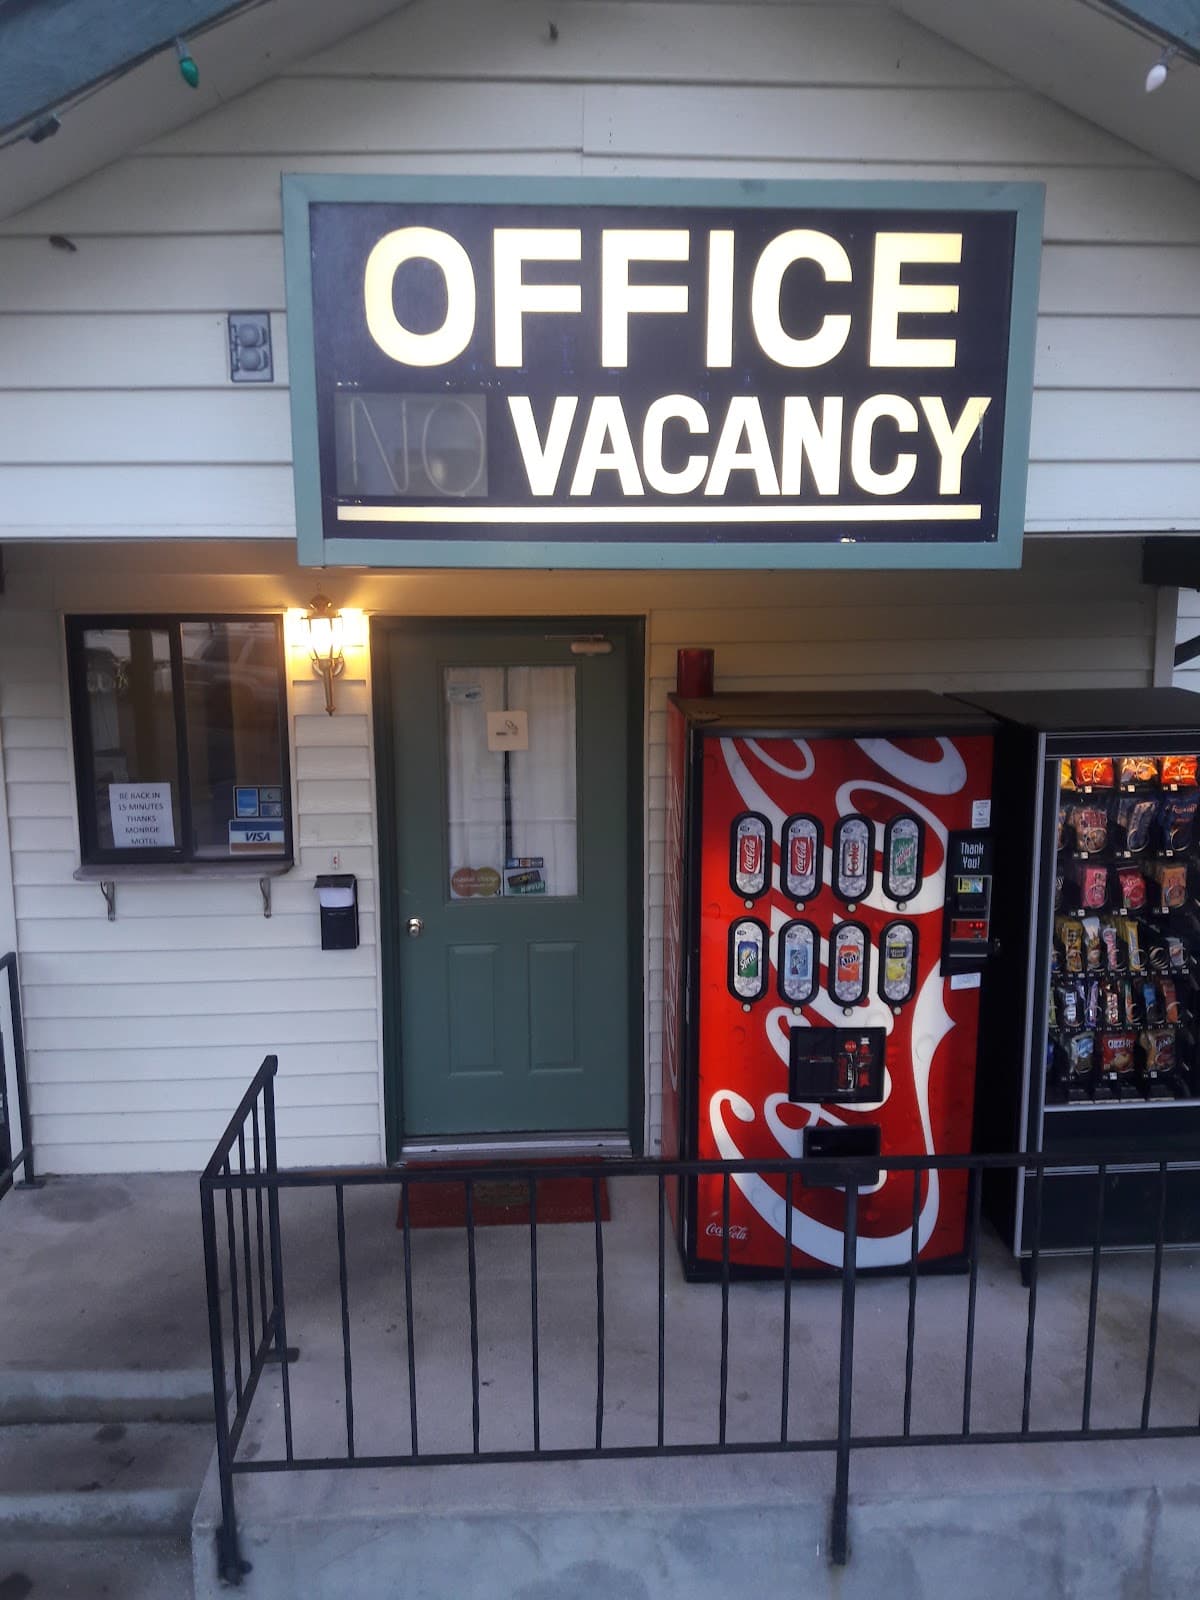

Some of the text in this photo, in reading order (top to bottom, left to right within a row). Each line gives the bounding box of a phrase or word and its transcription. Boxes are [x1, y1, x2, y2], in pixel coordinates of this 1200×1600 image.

[364, 226, 963, 369] OFFICE
[350, 394, 992, 498] NO VACANCY
[130, 791, 150, 800] BACK
[151, 791, 161, 799] IN
[119, 802, 164, 811] 15 MINUTES
[127, 815, 157, 823] THANKS
[245, 831, 271, 842] VISA
[961, 842, 985, 855] Thank
[962, 856, 980, 869] You!
[740, 950, 757, 971] Sprite
